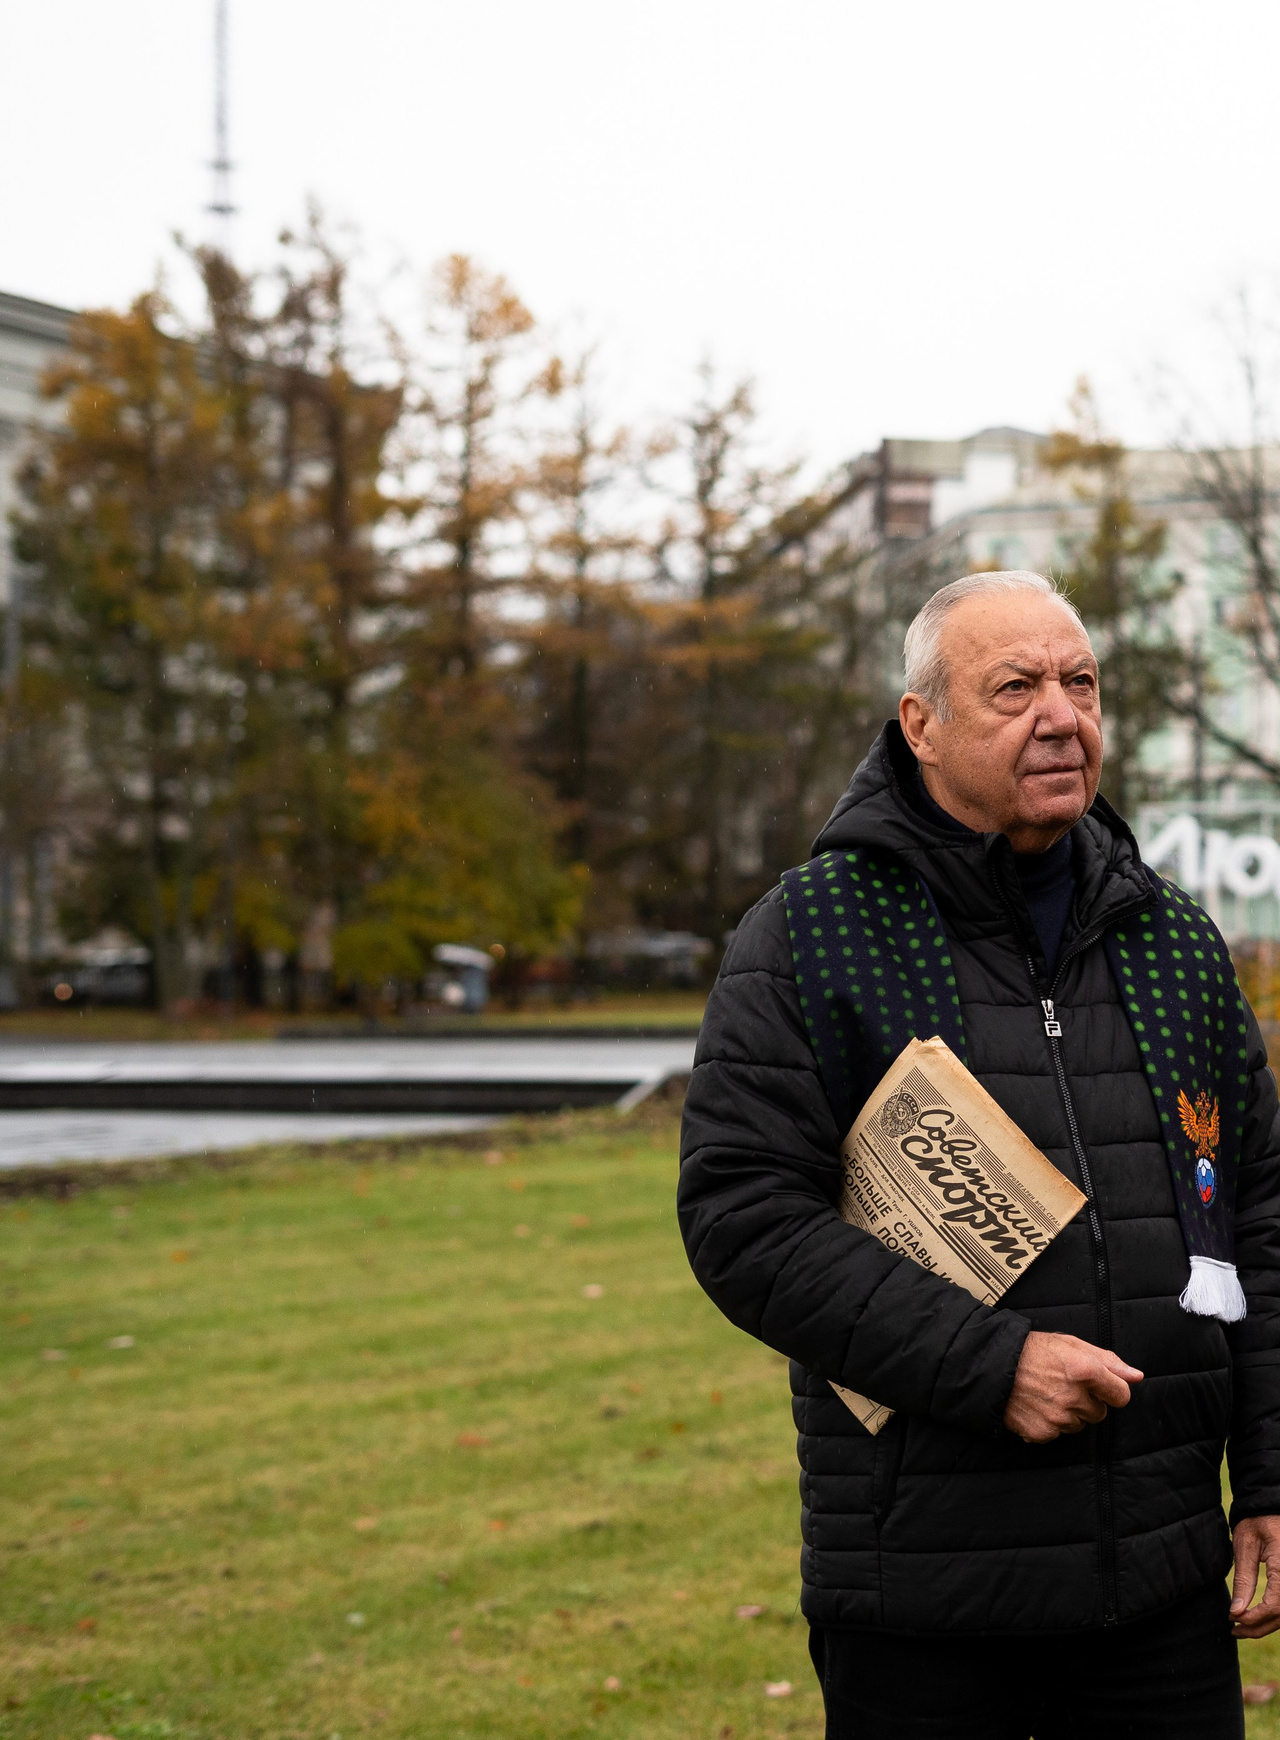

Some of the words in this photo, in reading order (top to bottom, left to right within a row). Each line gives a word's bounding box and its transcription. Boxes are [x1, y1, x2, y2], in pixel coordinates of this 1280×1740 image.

[904, 1094, 917, 1111] СССР
[840, 1165, 879, 1225] БОЛЬШЕ
[876, 1225, 911, 1257] ПОЛ
[843, 1153, 893, 1217] «БОЛЬШЕ
[894, 1221, 938, 1270] СЛАВЫ
[890, 1200, 902, 1214] Труда
[1034, 1199, 1047, 1212] ВСЕХ
